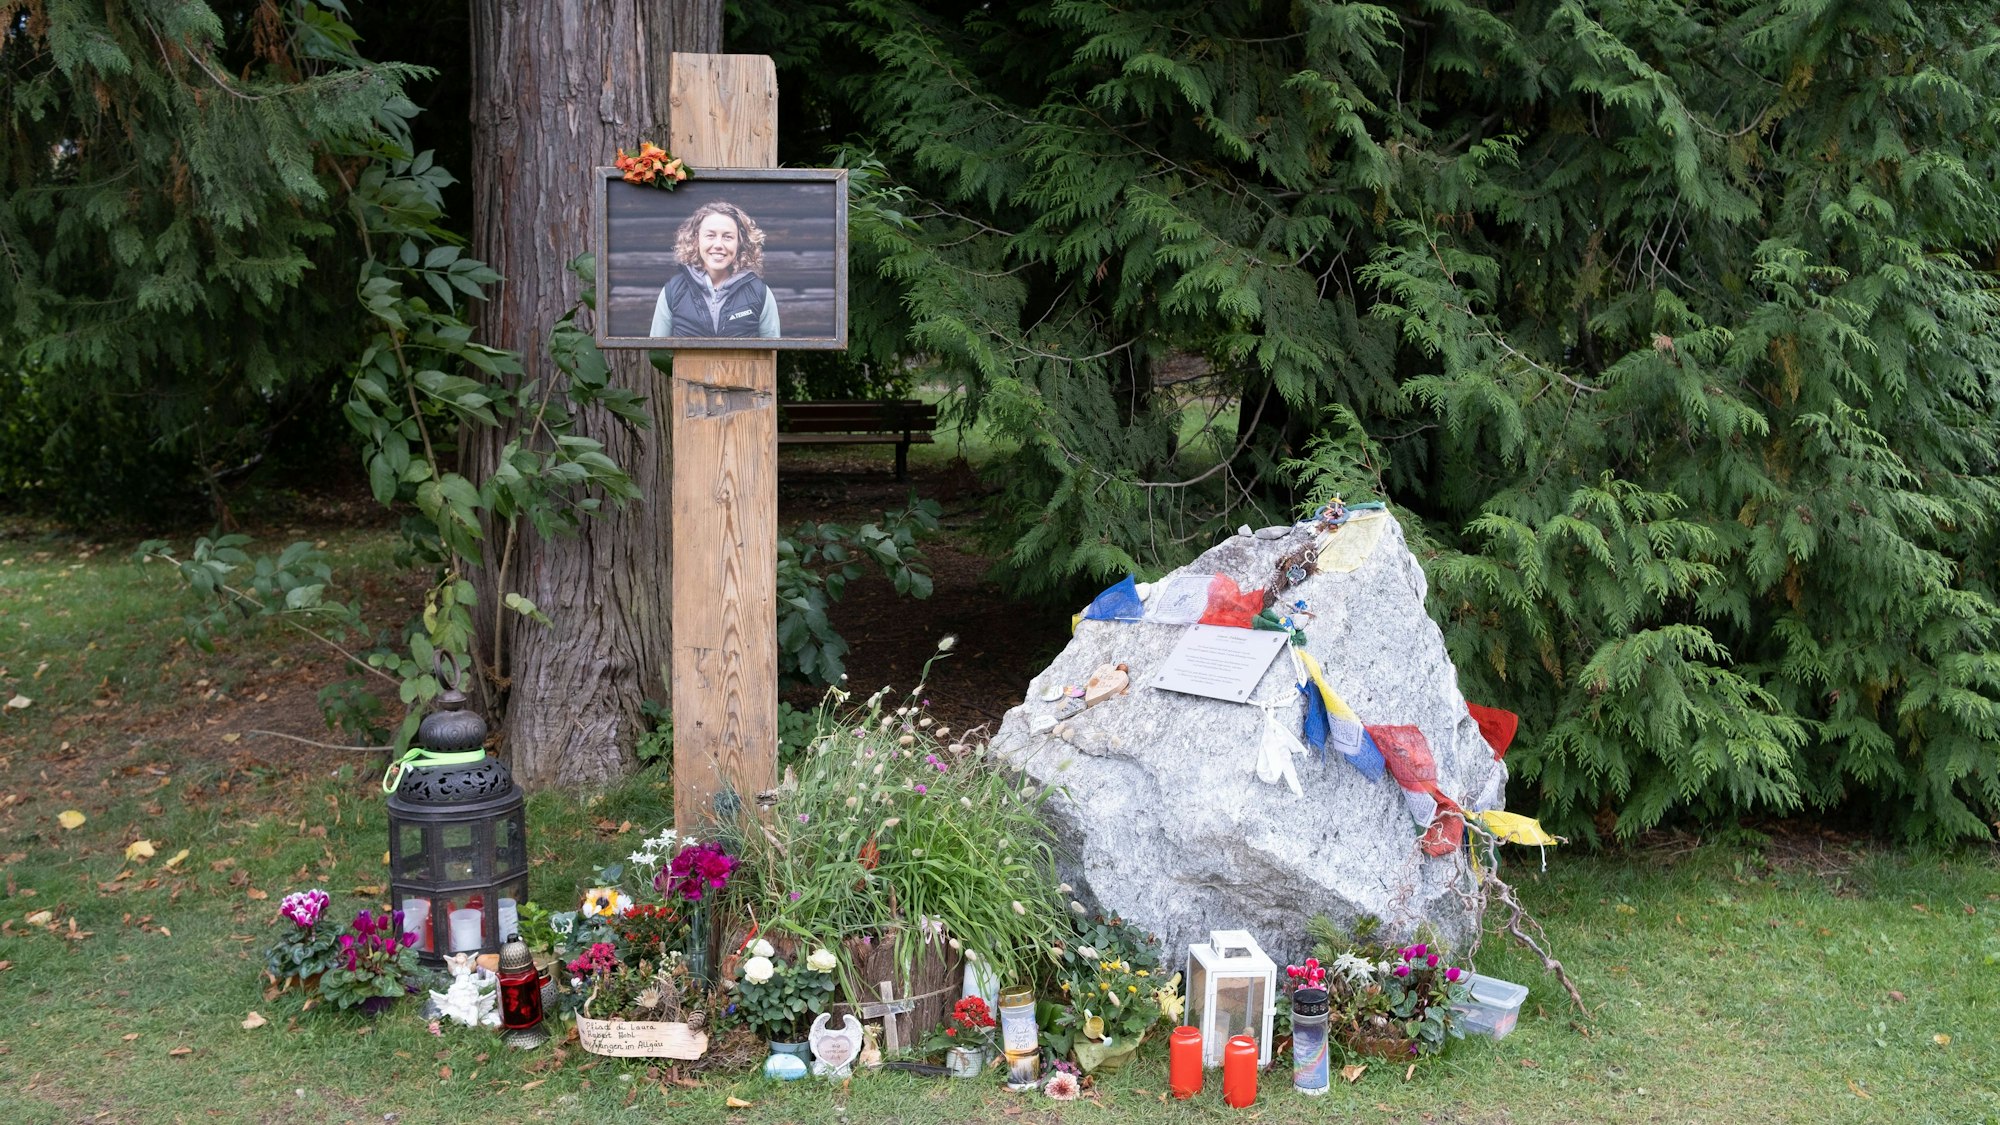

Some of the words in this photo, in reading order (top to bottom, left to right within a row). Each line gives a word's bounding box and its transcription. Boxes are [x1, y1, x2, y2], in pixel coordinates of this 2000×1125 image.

[631, 1023, 656, 1031] Laura
[625, 1041, 634, 1050] im
[638, 1039, 664, 1052] Allgäu
